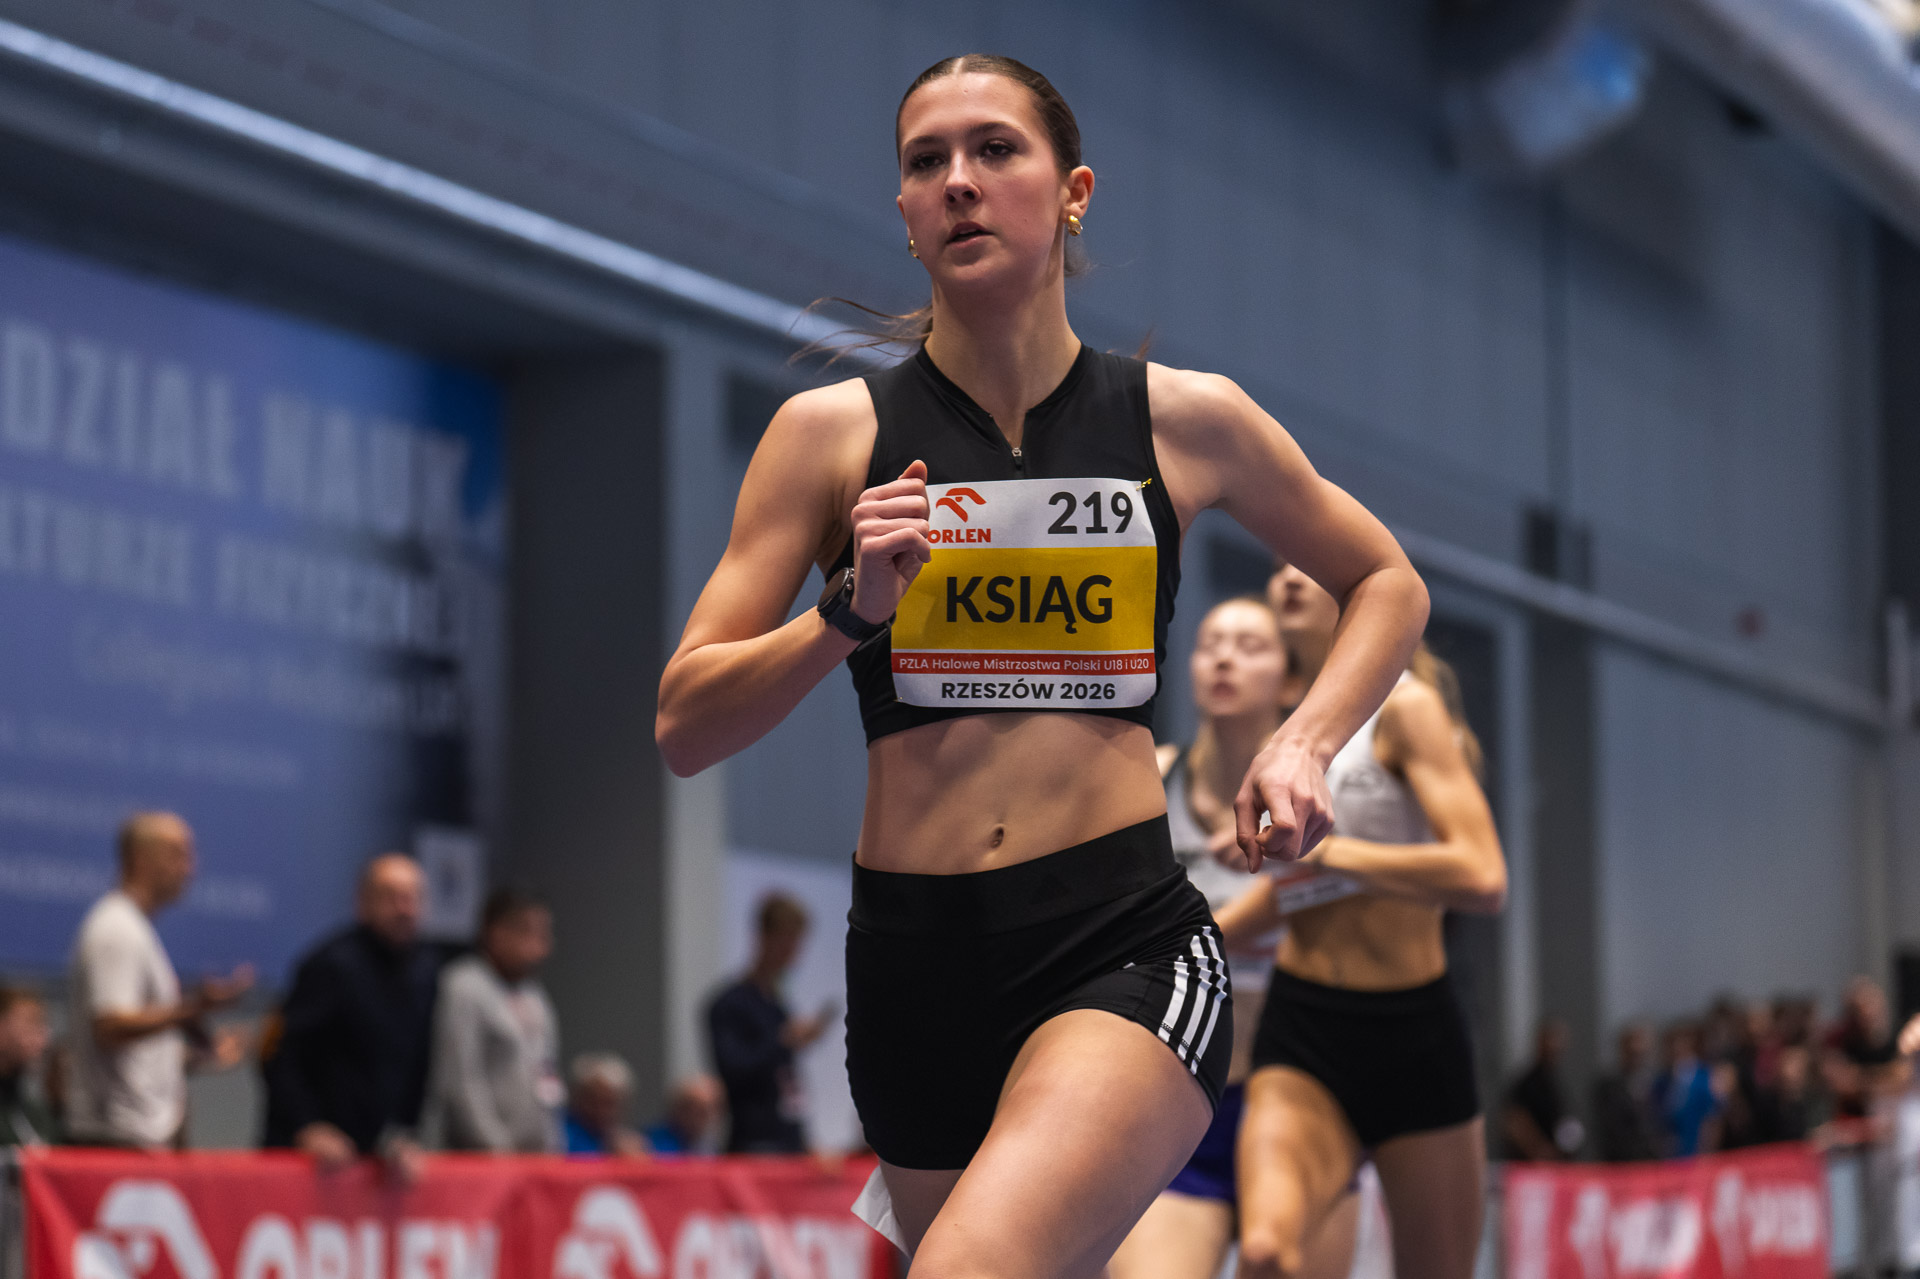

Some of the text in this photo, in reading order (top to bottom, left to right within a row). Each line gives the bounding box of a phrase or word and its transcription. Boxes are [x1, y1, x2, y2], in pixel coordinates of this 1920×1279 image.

[928, 491, 1133, 544] ORLEN 219
[946, 574, 1113, 634] KSIĄG
[899, 658, 929, 670] PZLA
[932, 658, 981, 670] Halowe
[983, 658, 1061, 671] Mistrzostwa
[1064, 658, 1101, 671] Polski
[1103, 659, 1123, 671] U18
[1130, 658, 1150, 670] U20
[941, 678, 1116, 700] RZESZÓW 2026
